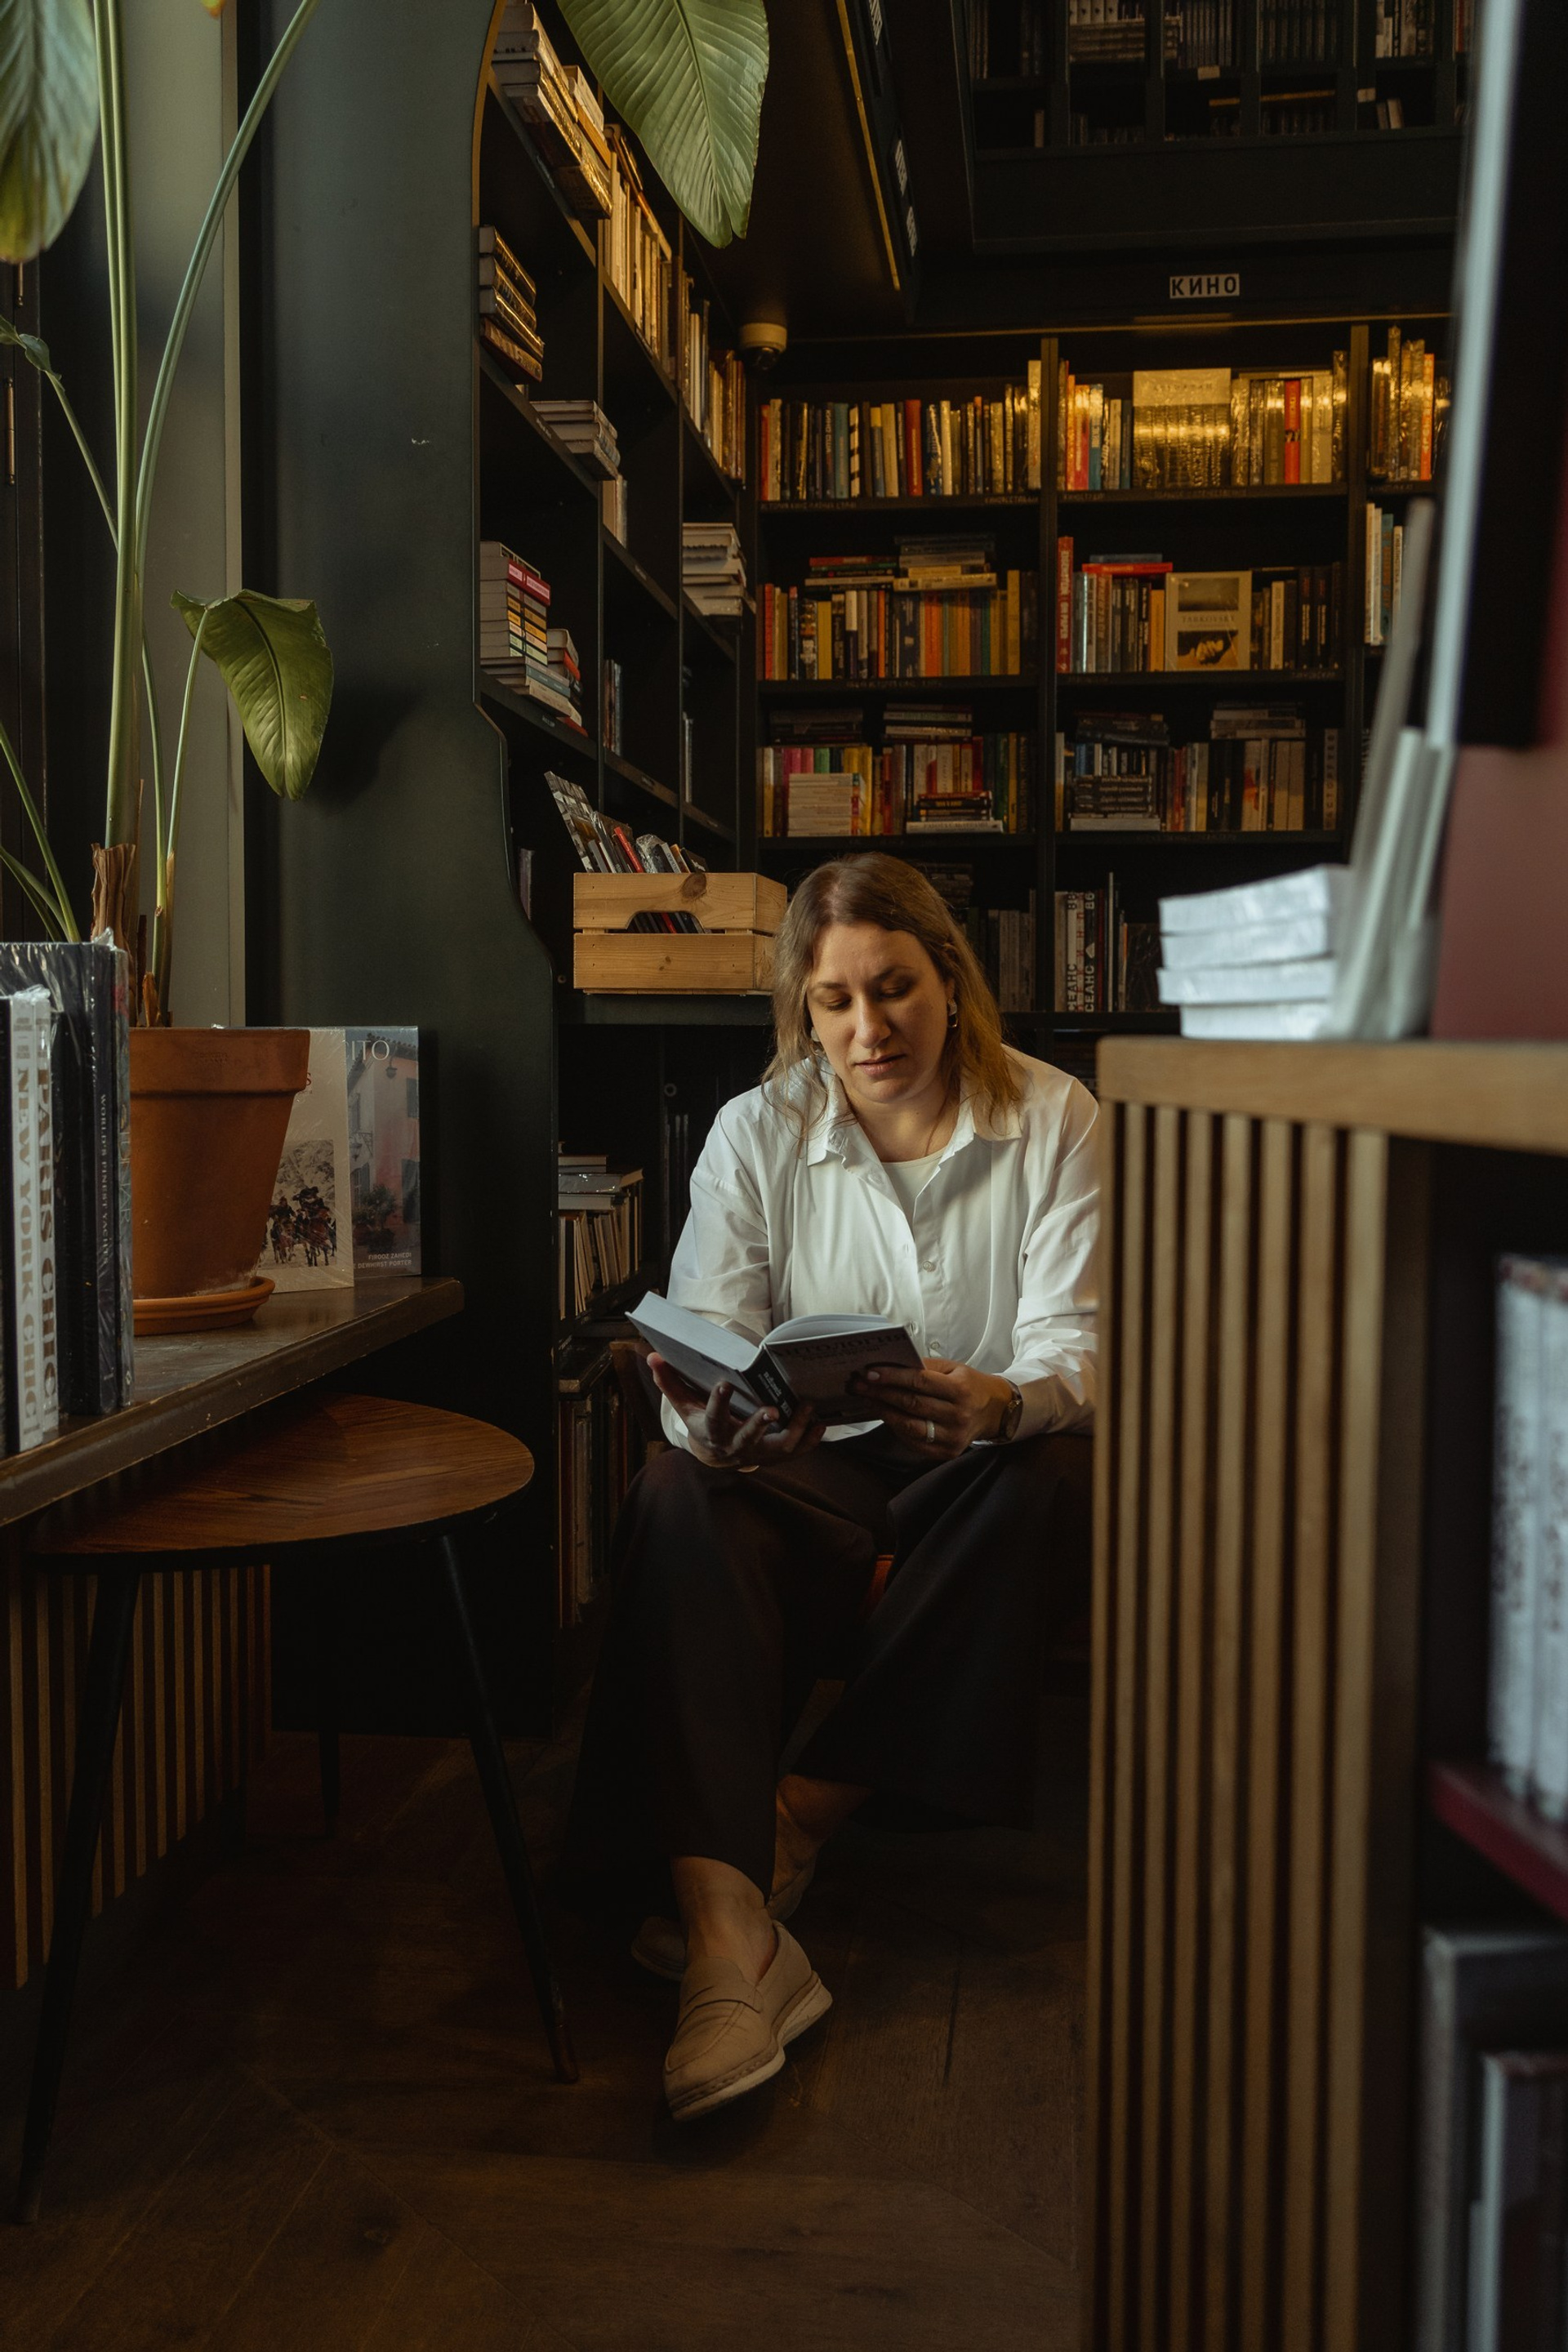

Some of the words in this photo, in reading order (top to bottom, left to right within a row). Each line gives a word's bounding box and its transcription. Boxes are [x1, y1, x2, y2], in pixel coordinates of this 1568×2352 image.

[1172, 276, 1236, 296] КИНО
[1181, 615, 1236, 624] TARKOVSKY
[1085, 893, 1094, 910] 86
[1067, 964, 1077, 1012] СЕАНС
[1085, 965, 1094, 1013] СЕАНС
[16, 1067, 32, 1168] NEW
[37, 1068, 53, 1244] PARIS
[18, 1178, 34, 1302] YORK
[41, 1257, 57, 1397] CHIC
[21, 1313, 38, 1420] CHIC
